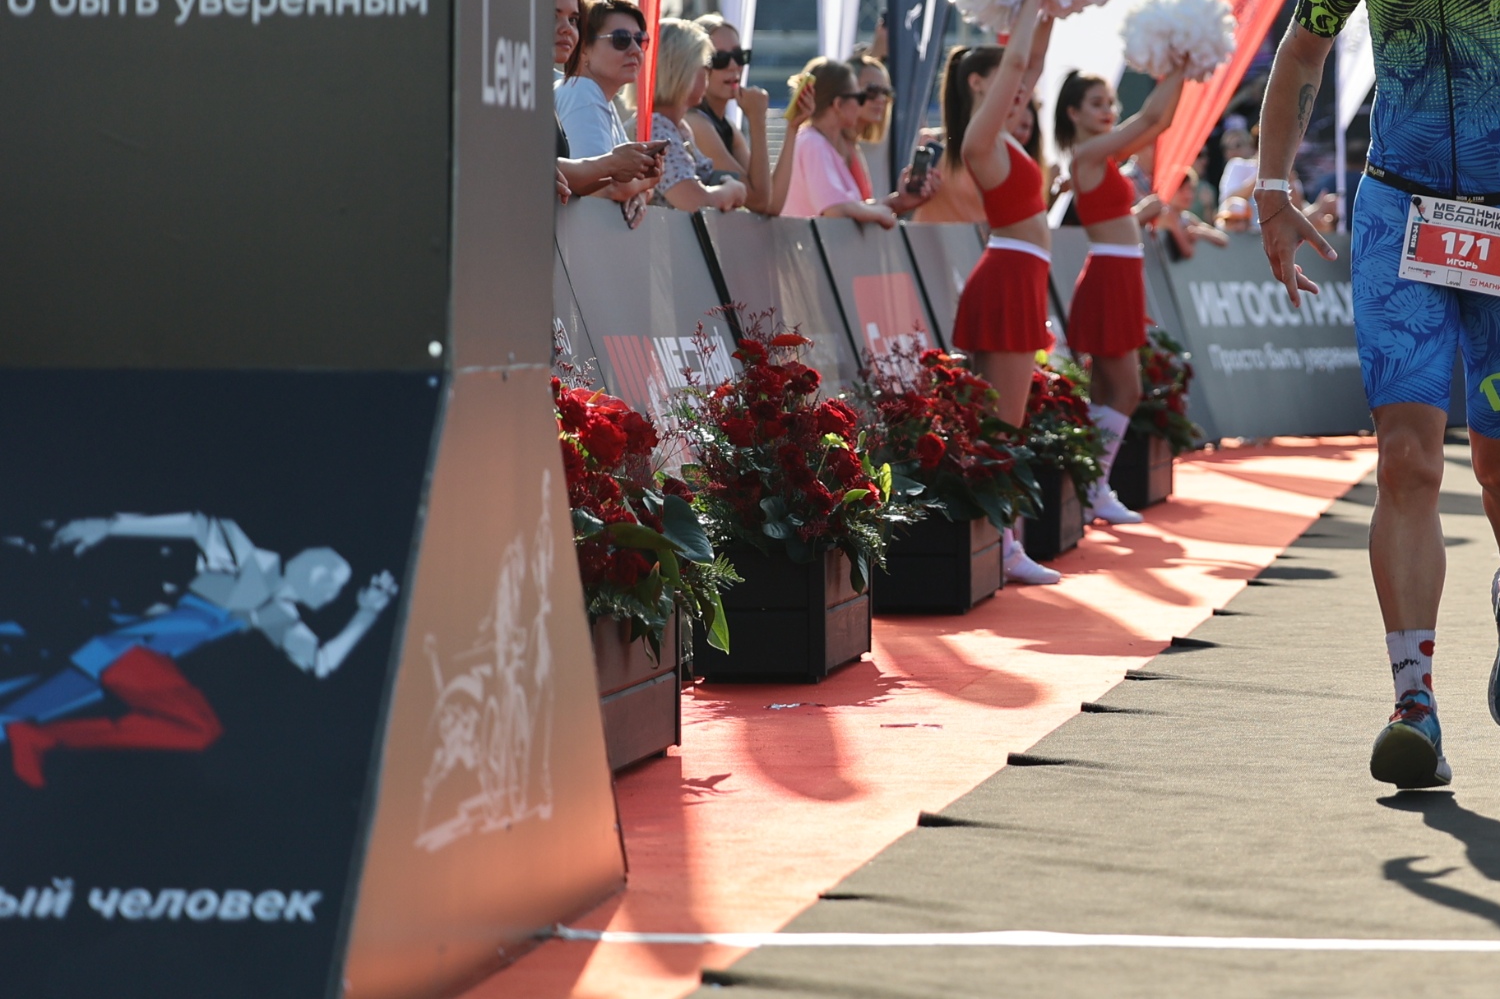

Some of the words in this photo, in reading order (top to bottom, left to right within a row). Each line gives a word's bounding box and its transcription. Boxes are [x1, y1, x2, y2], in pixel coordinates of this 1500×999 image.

[1441, 231, 1491, 261] 171
[1446, 257, 1479, 270] ИГОРЬ
[87, 887, 322, 922] человек
